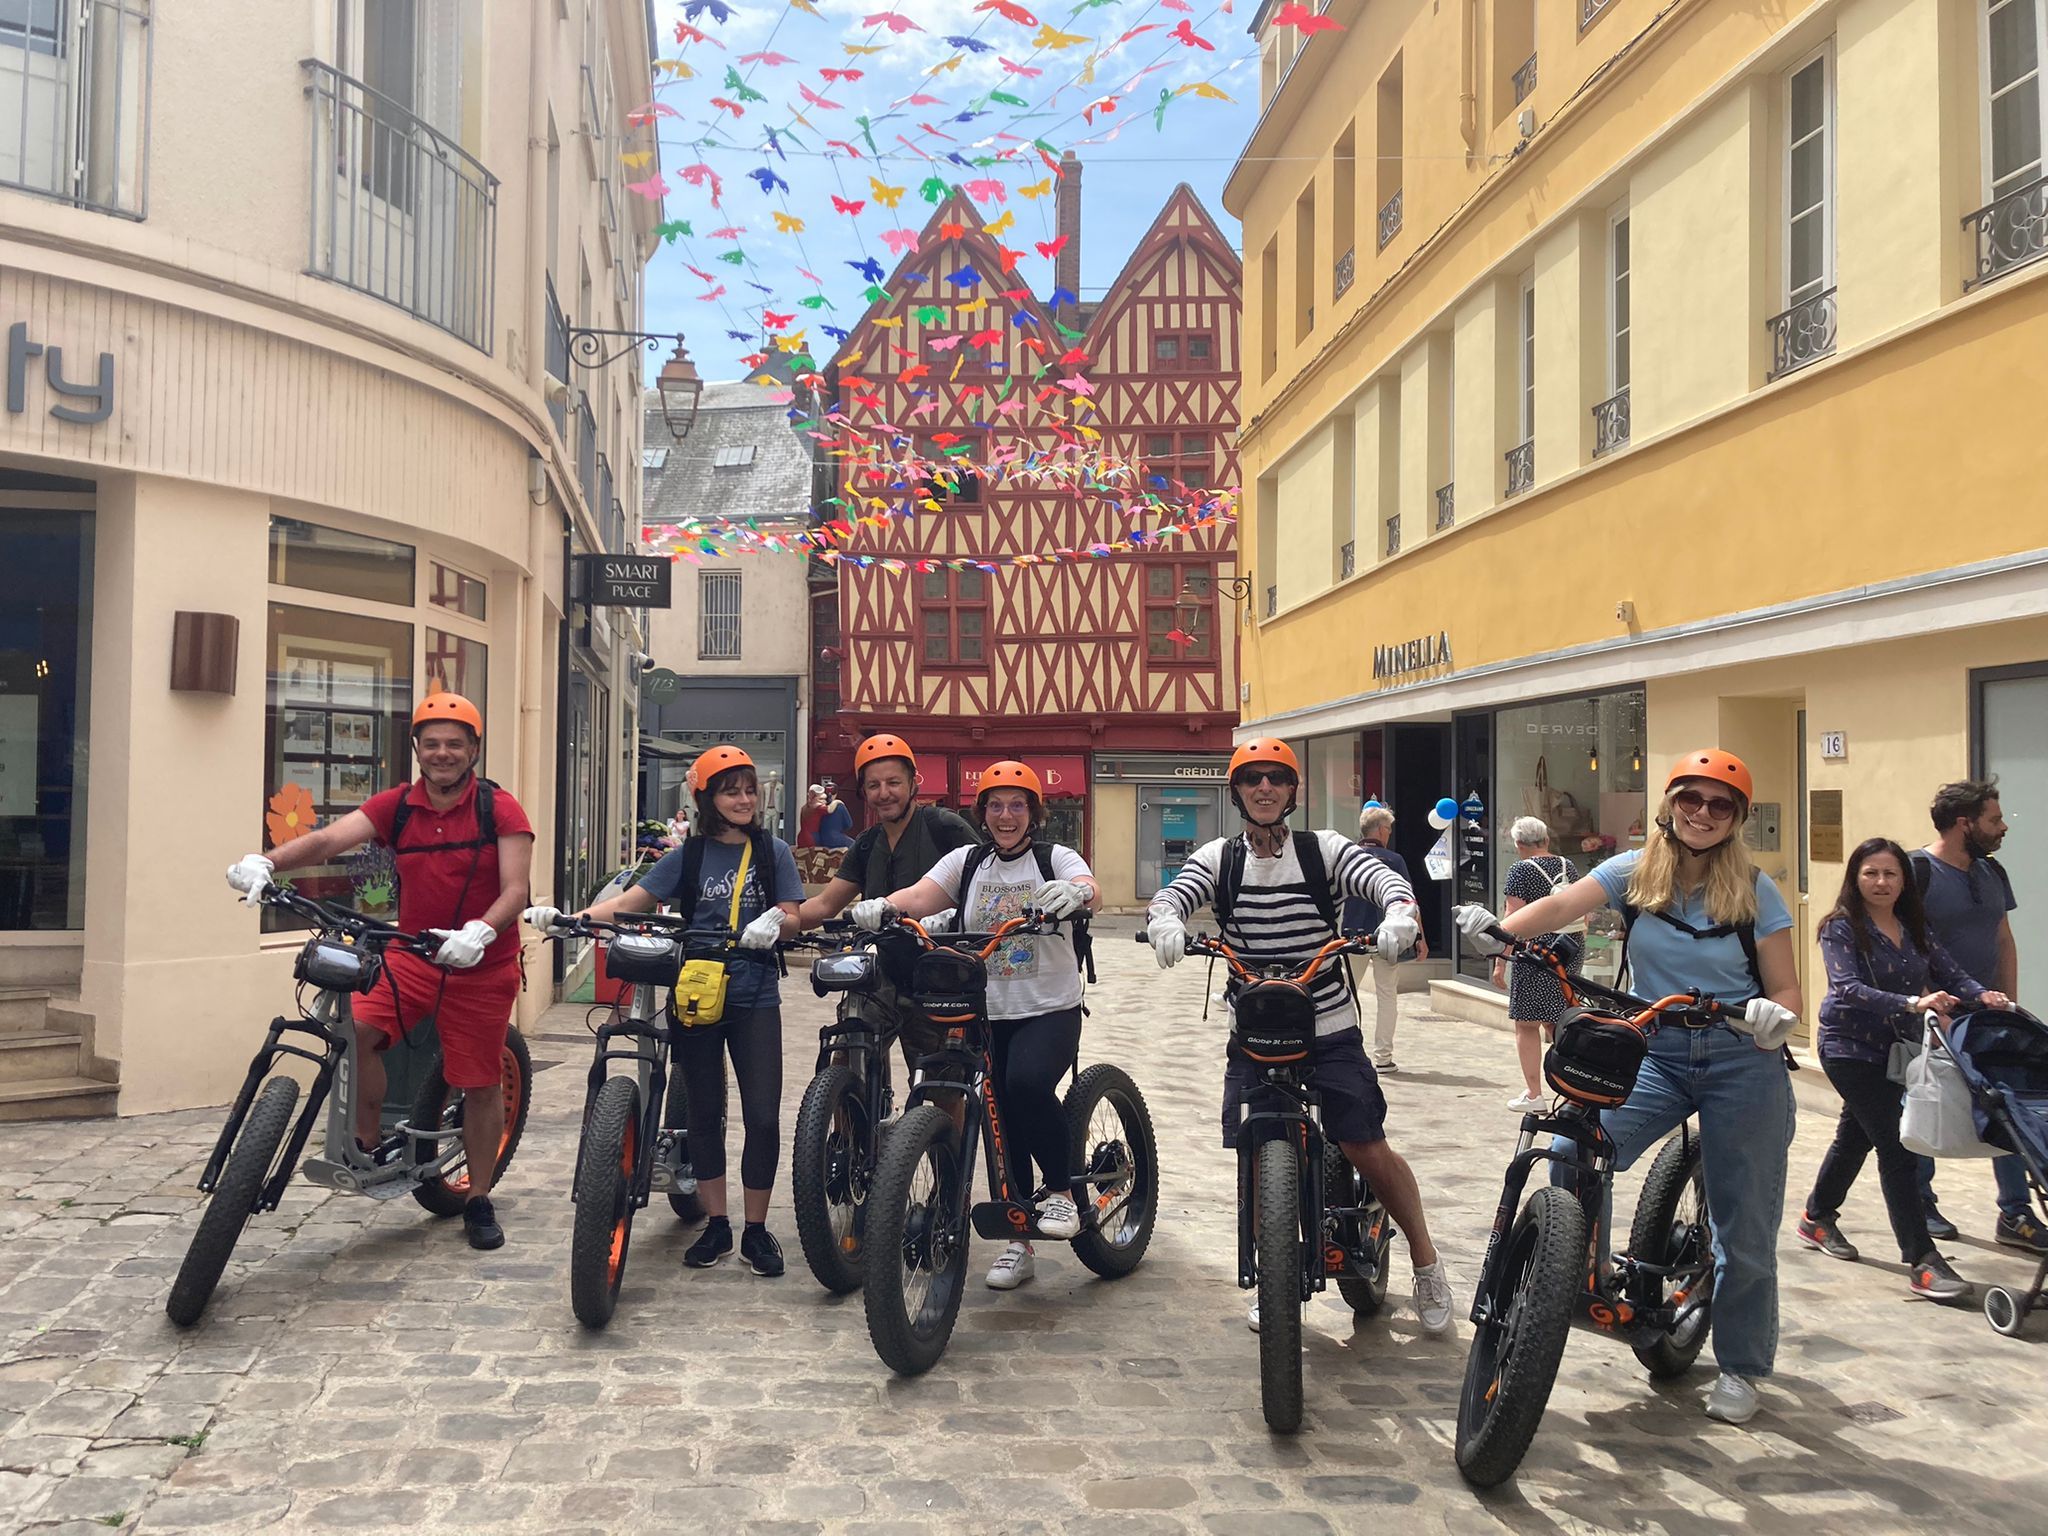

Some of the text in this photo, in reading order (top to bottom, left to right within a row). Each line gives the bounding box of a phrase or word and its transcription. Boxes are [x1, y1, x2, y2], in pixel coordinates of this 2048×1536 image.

[605, 563, 659, 579] SMART
[613, 585, 652, 598] PLACE
[1373, 631, 1453, 679] MINELLA
[1827, 736, 1840, 754] 16
[1174, 766, 1220, 776] CRÉDIT
[982, 884, 1031, 893] BLOSSOMS
